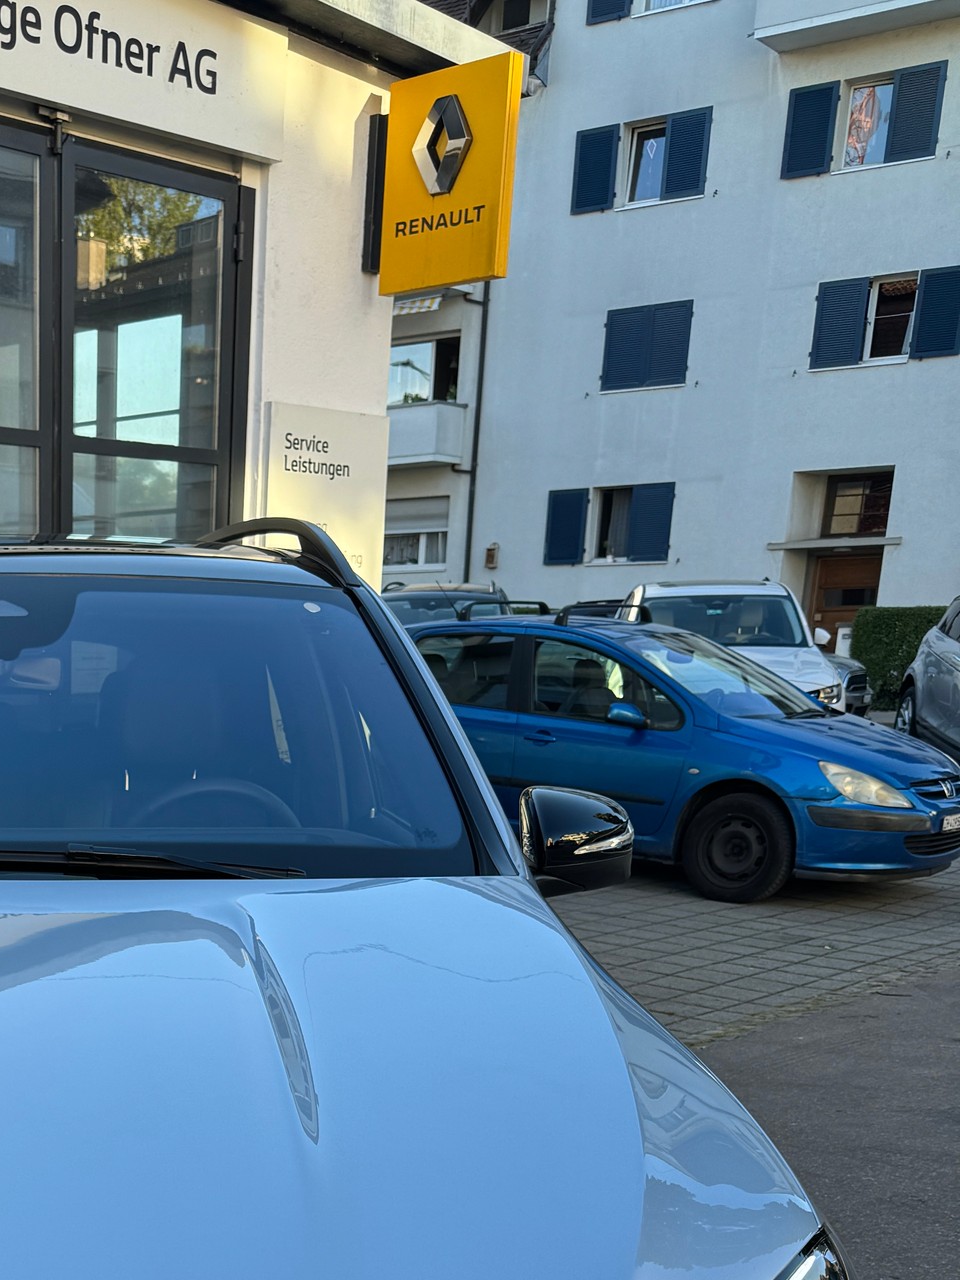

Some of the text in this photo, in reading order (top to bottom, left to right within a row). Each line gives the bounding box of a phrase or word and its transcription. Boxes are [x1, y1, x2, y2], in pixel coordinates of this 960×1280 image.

[54, 4, 160, 77] Ofner
[168, 40, 218, 95] AG
[394, 204, 486, 238] RENAULT
[284, 432, 329, 453] Service
[284, 454, 350, 480] Leistungen
